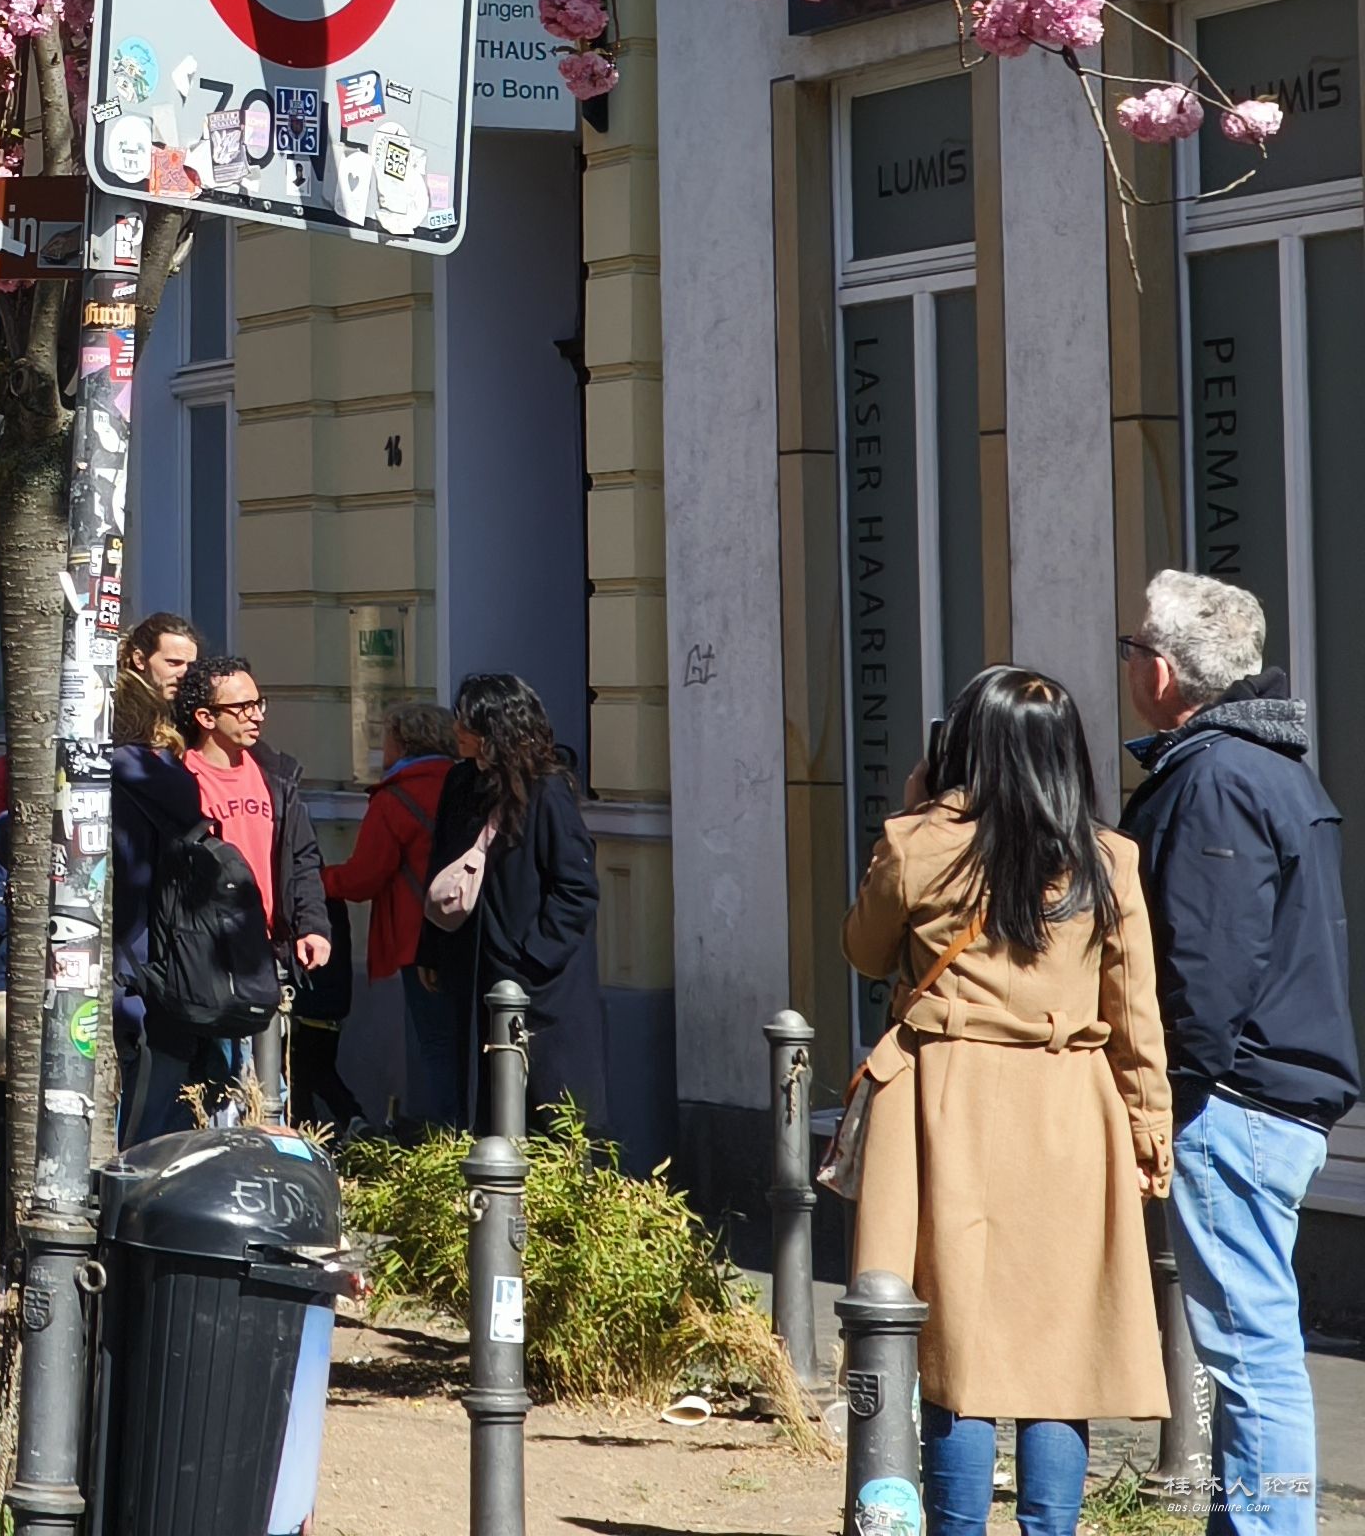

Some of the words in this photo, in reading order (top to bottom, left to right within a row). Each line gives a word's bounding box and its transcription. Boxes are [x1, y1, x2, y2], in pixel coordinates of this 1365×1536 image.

[502, 79, 560, 100] Bonn
[878, 148, 967, 198] LUMIS
[854, 338, 883, 492] LASER
[858, 516, 889, 834] HAARENTFE
